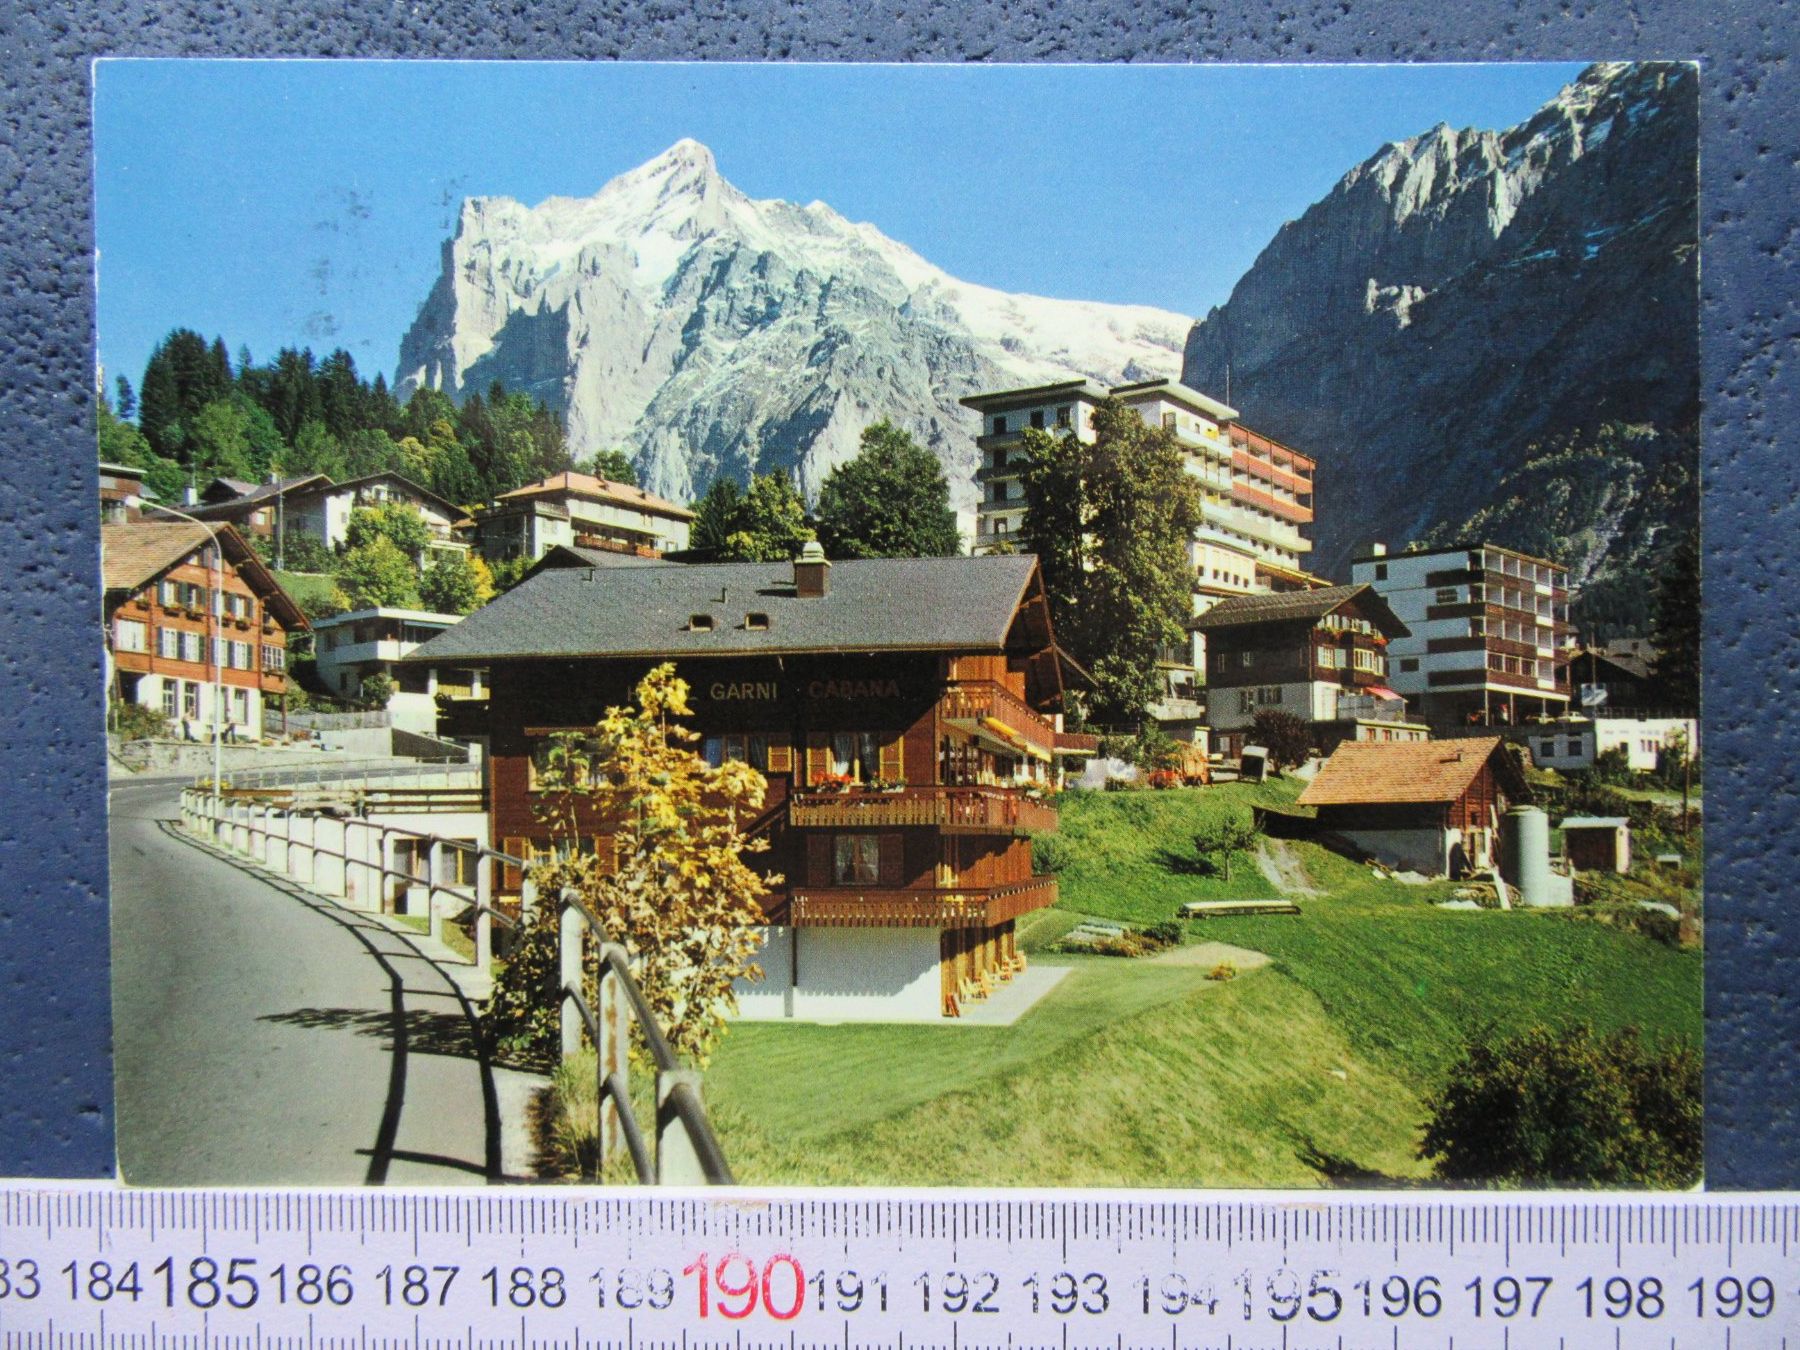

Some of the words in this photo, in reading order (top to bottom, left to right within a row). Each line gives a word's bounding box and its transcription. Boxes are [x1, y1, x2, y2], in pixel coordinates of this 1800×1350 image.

[710, 682, 777, 700] GARNI
[808, 679, 900, 698] CABANA
[62, 1260, 143, 1301] 184
[154, 1257, 261, 1309] 185
[270, 1264, 353, 1305] 186
[376, 1265, 459, 1306] 187
[482, 1267, 566, 1308] 188
[588, 1267, 675, 1309] 189
[683, 1252, 806, 1320] 190
[809, 1270, 887, 1312] 191
[914, 1272, 999, 1313] 192
[1023, 1273, 1109, 1314] 193
[1133, 1273, 1220, 1316] 194
[1232, 1269, 1342, 1321] 195
[1354, 1276, 1441, 1317] 196
[1465, 1276, 1553, 1318] 197
[1577, 1277, 1664, 1319] 198
[1688, 1276, 1775, 1318] 199
